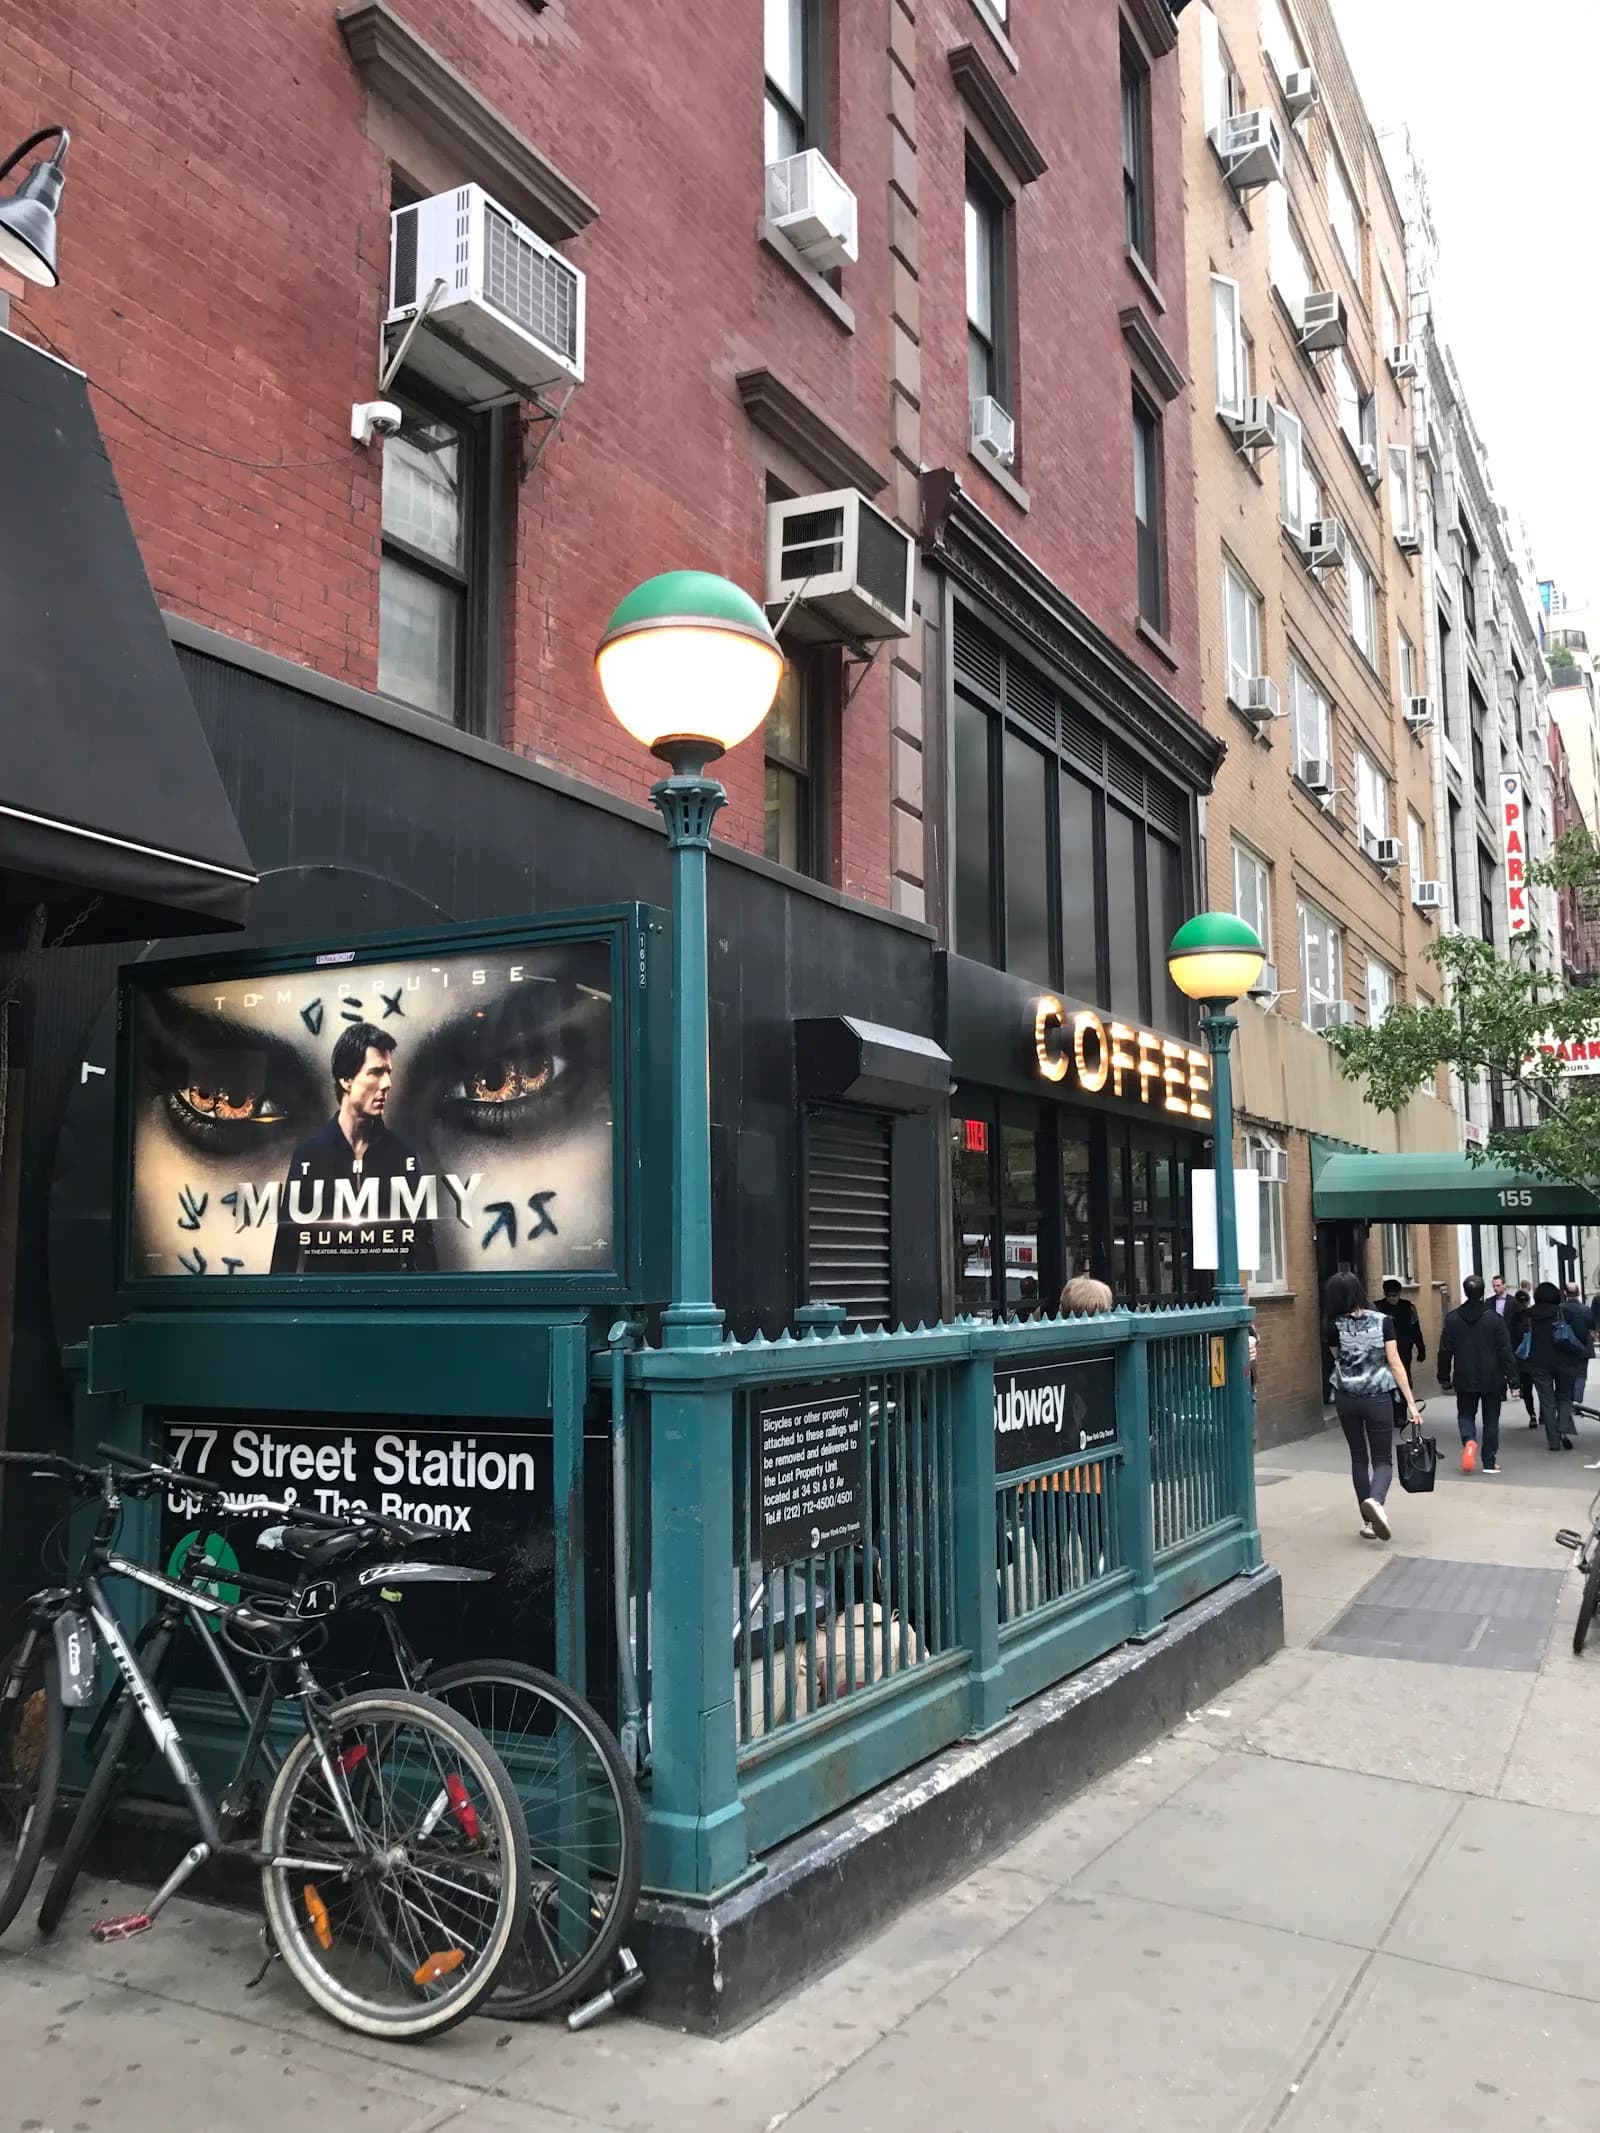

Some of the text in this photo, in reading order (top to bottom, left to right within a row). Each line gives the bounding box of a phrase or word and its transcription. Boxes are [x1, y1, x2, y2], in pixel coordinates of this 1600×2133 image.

[1505, 804, 1525, 910] PARK
[215, 966, 523, 1010] TOM CRUISE
[1034, 996, 1212, 1120] COFFEE
[301, 1157, 415, 1176] THE
[235, 1173, 486, 1233] MUMMY
[1498, 1190, 1532, 1207] 155
[299, 1229, 415, 1245] SUMMER
[763, 1406, 849, 1432] Bicycles or other property
[763, 1420, 858, 1451] attached to these railings will
[170, 1428, 535, 1491] 77 Street Station
[763, 1439, 857, 1469] be removed and delivered to
[764, 1459, 838, 1488] the Lost Property Unit
[763, 1476, 844, 1507] located at 34 St & 8 Av
[783, 1502, 801, 1521] (212)
[801, 1490, 853, 1515] 712-4500/4501
[382, 1493, 471, 1532] Bronx
